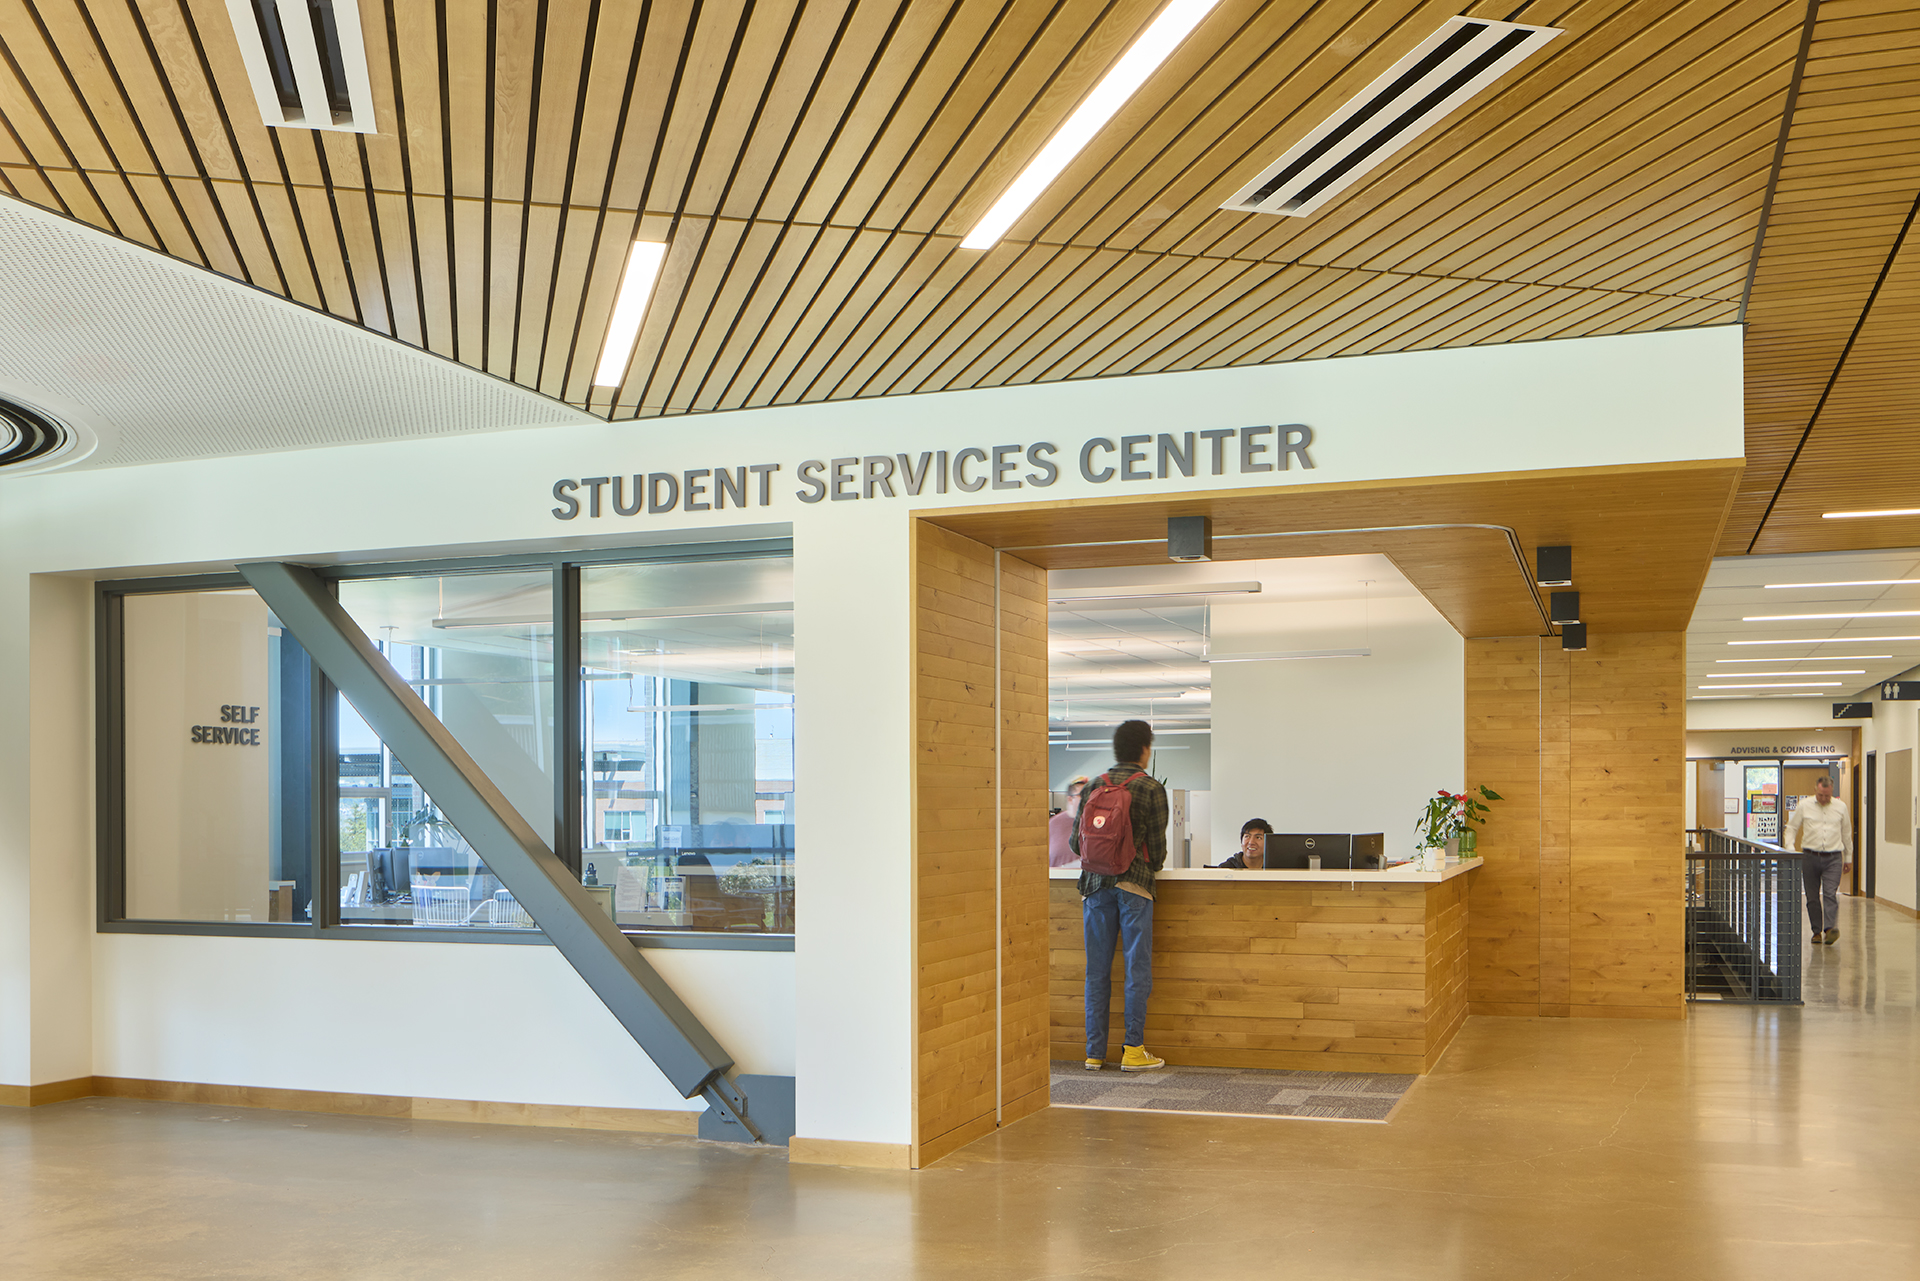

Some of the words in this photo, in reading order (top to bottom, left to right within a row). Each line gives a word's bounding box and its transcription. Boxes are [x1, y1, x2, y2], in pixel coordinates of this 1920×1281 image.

[551, 463, 780, 520] STUDENT
[795, 441, 1058, 503] SERVICES
[1079, 423, 1315, 483] CENTER
[220, 704, 260, 723] SELF
[191, 725, 260, 746] SERVICE
[1730, 746, 1770, 754] ADVISING
[1772, 746, 1779, 754] &
[1780, 745, 1836, 754] COUNSELING
